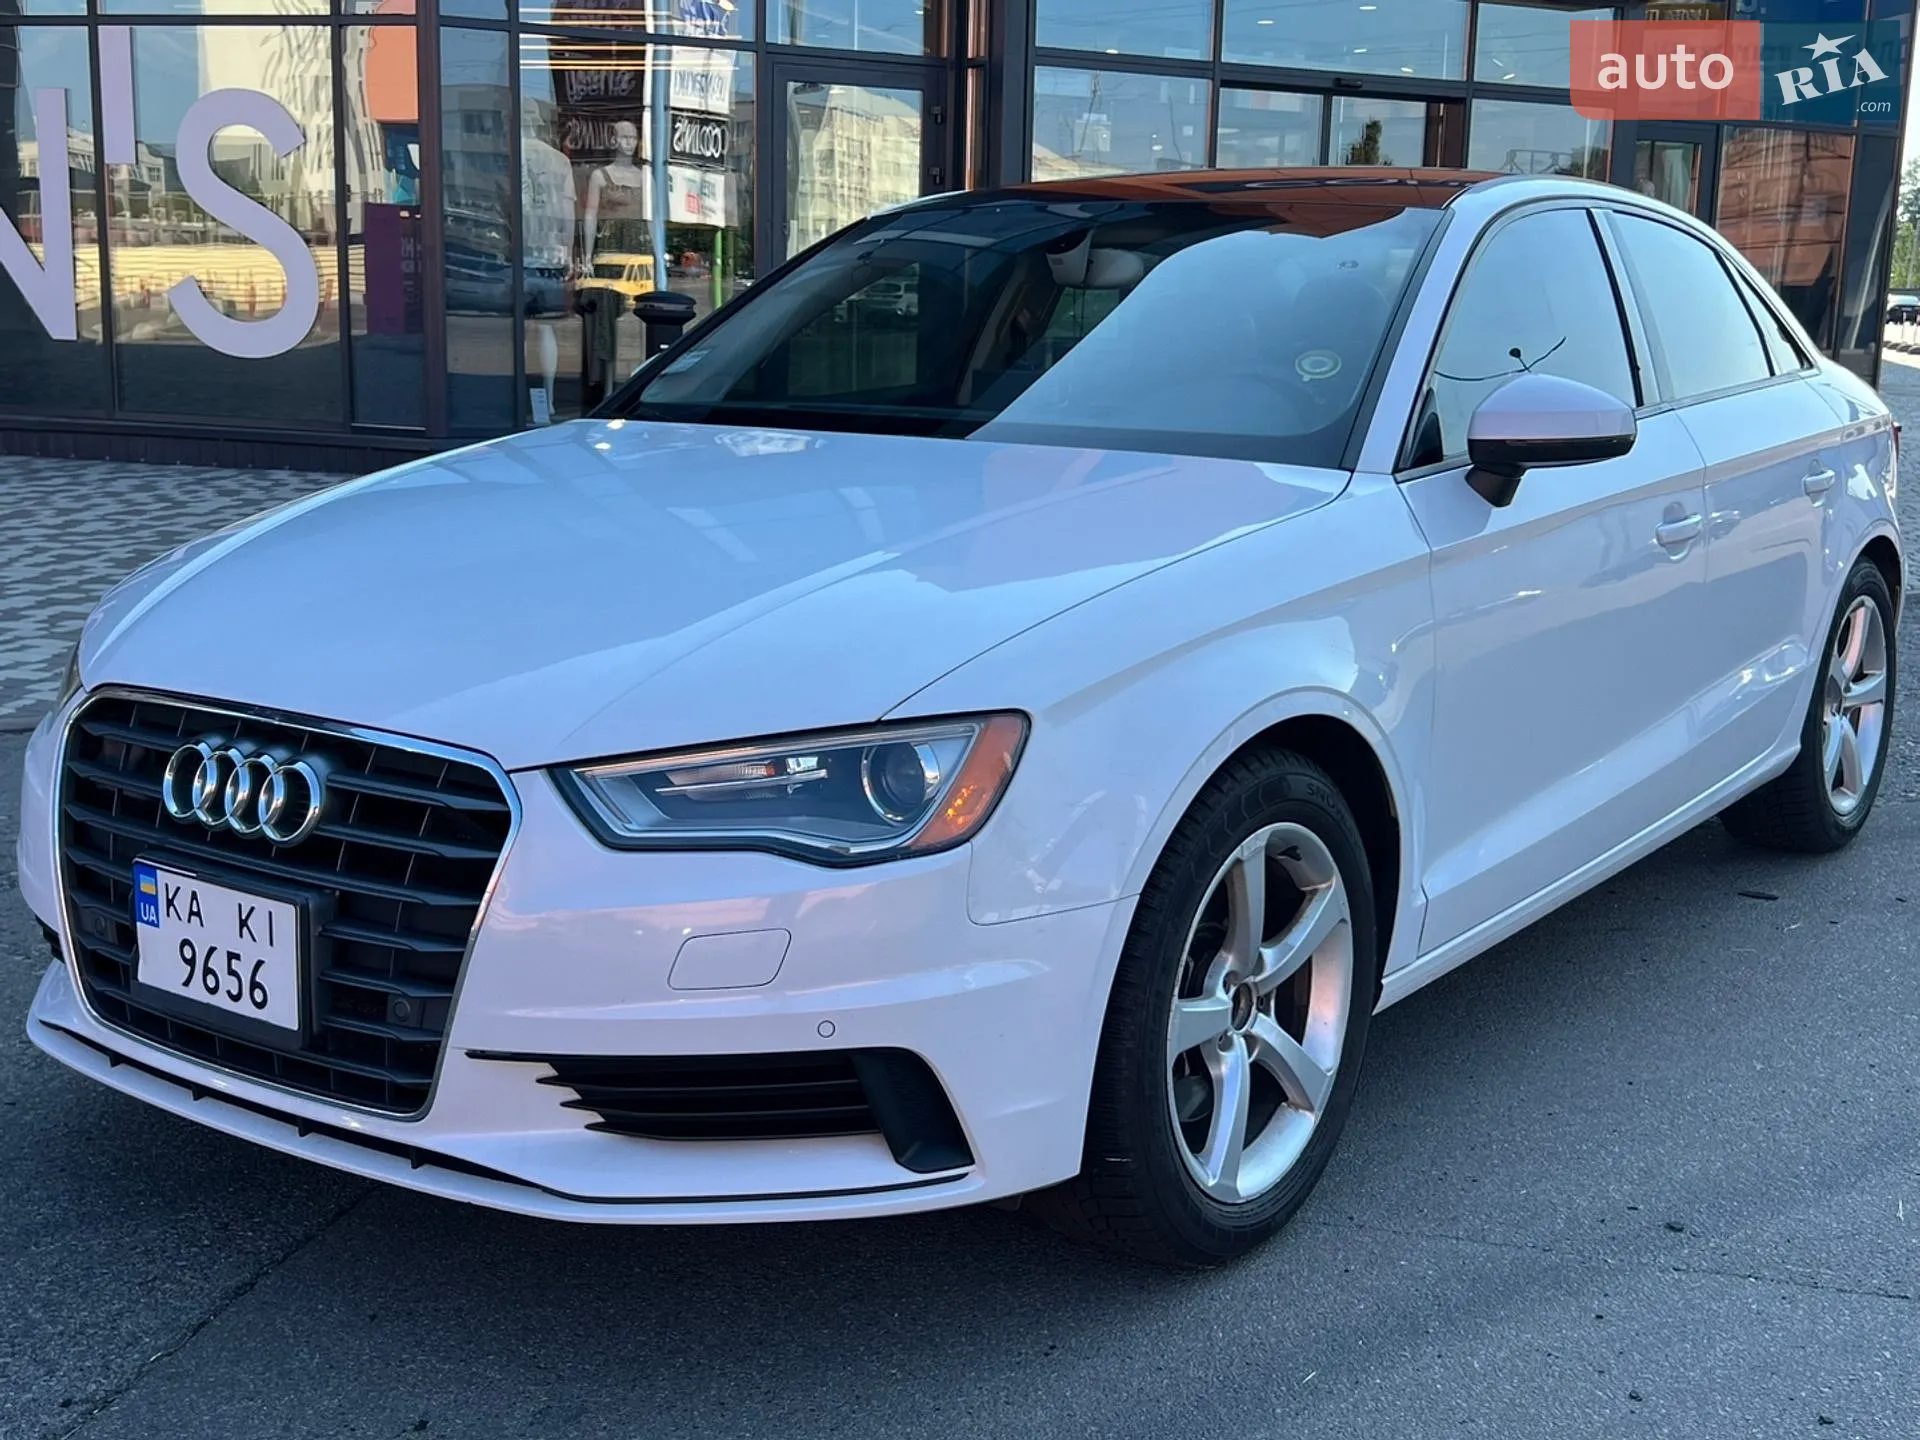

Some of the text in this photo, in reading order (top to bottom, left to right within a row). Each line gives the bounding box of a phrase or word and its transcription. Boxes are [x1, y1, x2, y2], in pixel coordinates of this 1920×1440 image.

[140, 902, 158, 925] UA
[164, 883, 274, 948] KA KI
[179, 938, 268, 1010] 9656
